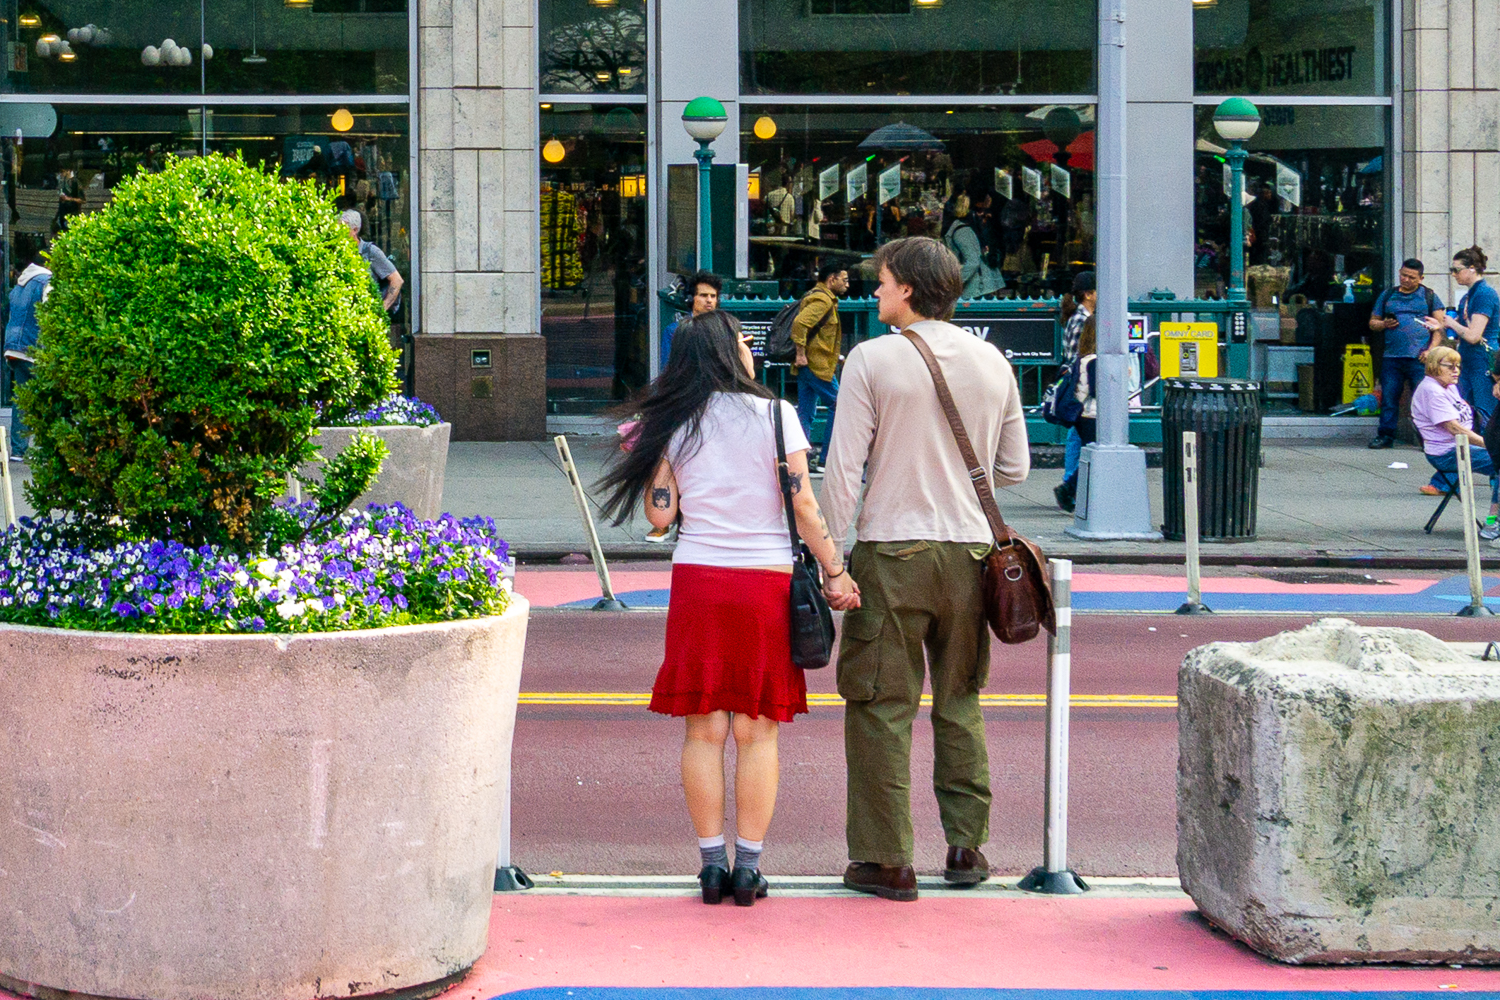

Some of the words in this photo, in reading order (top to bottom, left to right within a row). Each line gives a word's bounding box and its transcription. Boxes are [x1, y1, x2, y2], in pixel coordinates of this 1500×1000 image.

[1266, 46, 1357, 87] HEALTHIEST
[1164, 330, 1189, 338] OMNY
[1190, 330, 1214, 338] CARD
